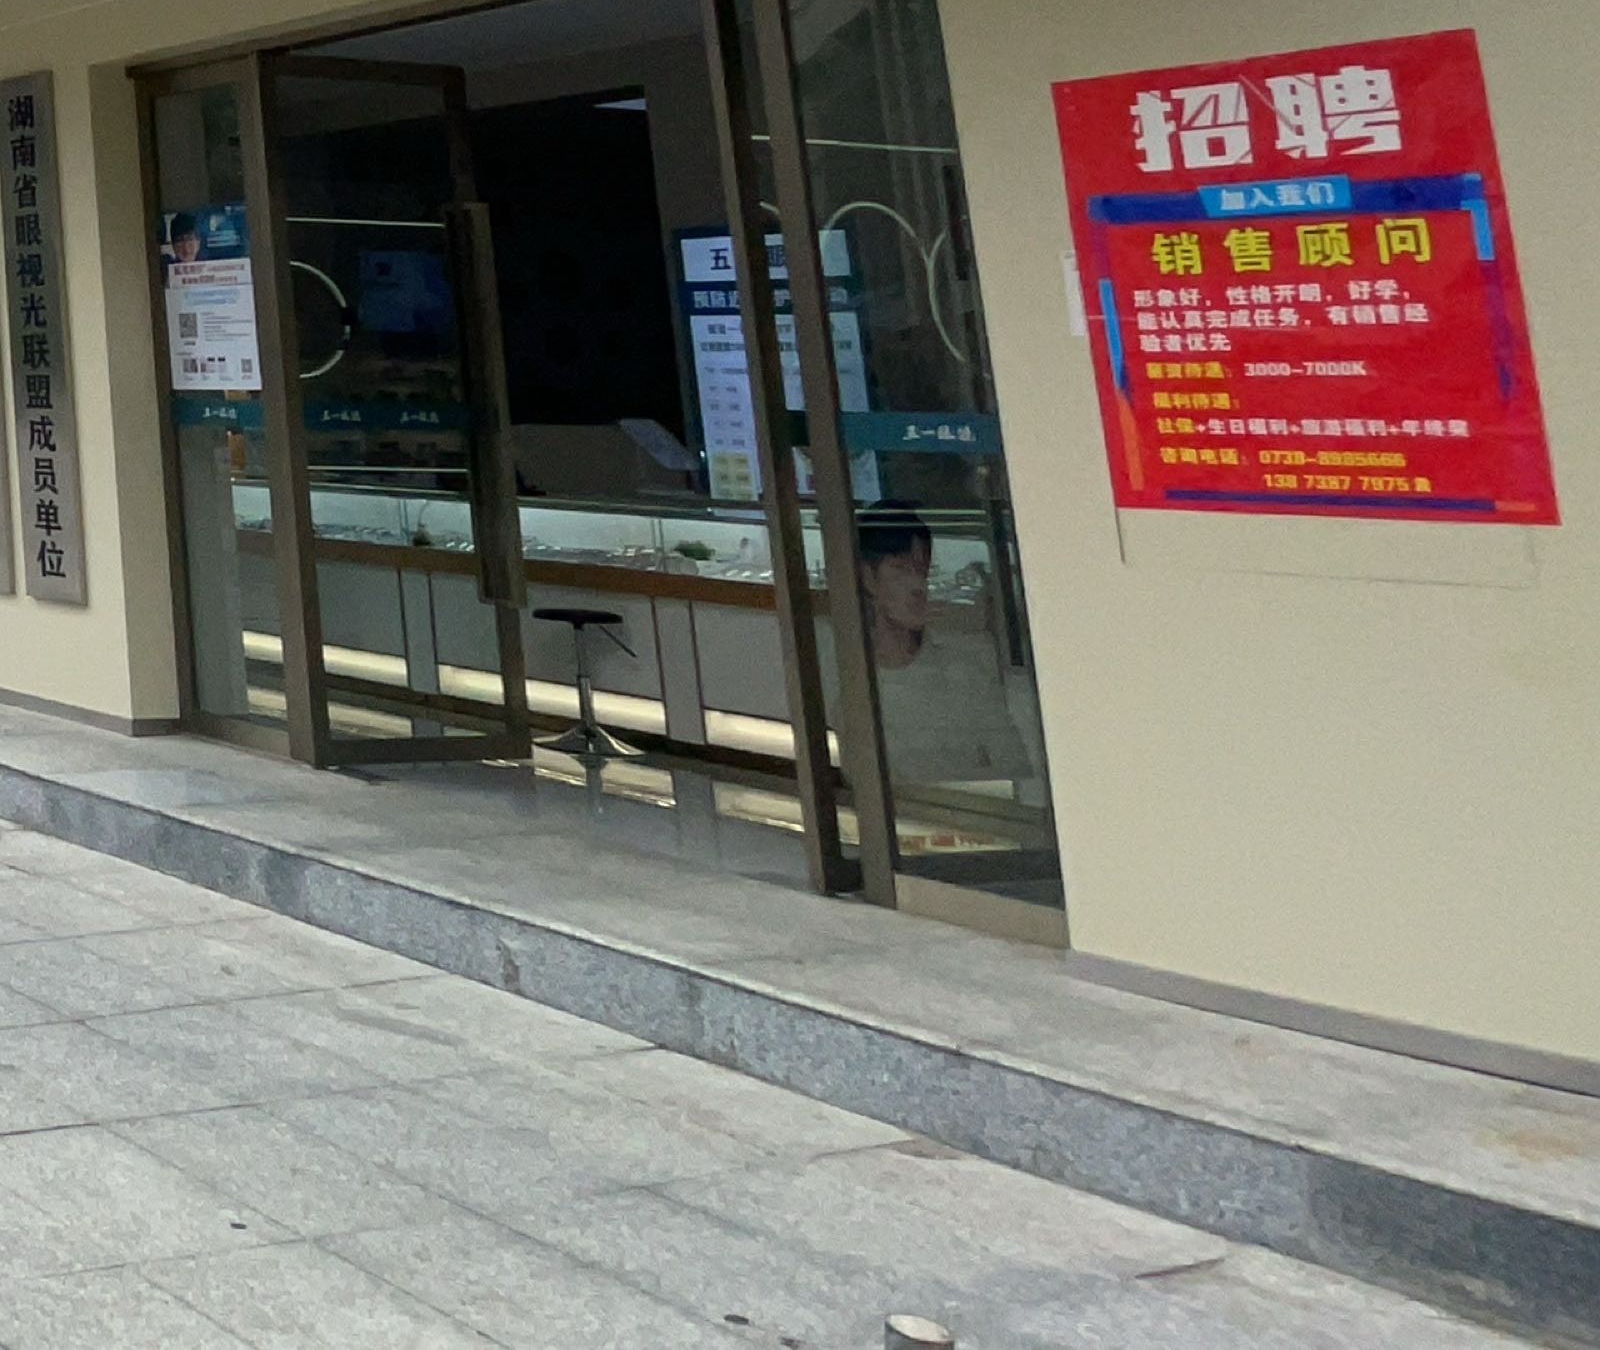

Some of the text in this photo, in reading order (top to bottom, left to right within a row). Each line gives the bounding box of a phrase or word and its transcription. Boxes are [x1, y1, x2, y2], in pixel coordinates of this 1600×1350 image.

[1130, 65, 1402, 172] 招聘
[1220, 181, 1335, 211] 加入我们
[1152, 218, 1432, 276] 销售顾问
[7, 94, 67, 580] 湖南省眼视光联盟成员单位
